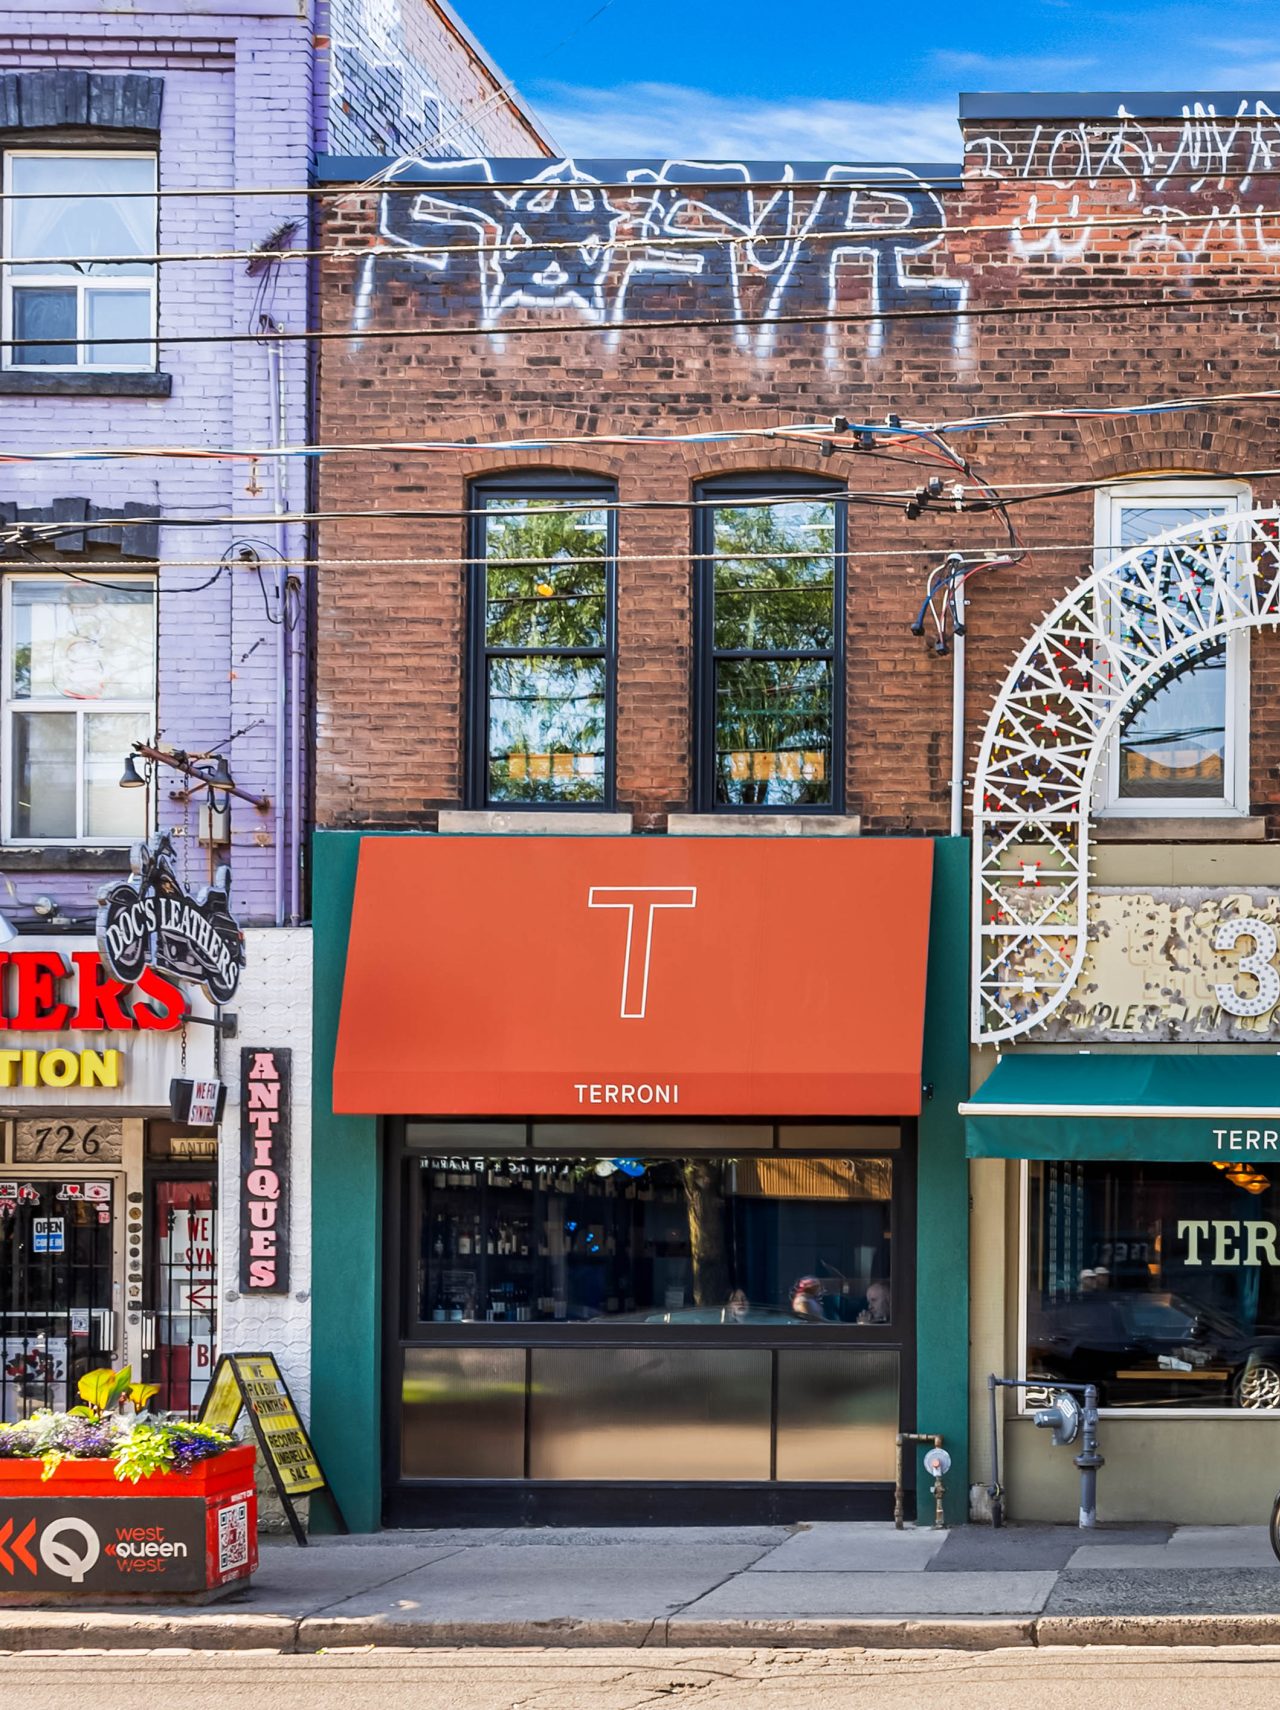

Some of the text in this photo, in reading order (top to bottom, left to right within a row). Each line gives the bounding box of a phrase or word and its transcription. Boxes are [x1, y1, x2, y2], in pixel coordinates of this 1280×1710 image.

[106, 897, 238, 990] DOC'S LEATHERS
[588, 886, 697, 1018] T
[0, 951, 186, 1031] ERS
[196, 1082, 207, 1100] WE
[573, 1083, 680, 1104] TERRONI
[190, 1105, 215, 1123] SYNTHS
[35, 1124, 100, 1156] 726
[246, 1052, 281, 1288] ANTIQUES
[35, 1221, 62, 1234] OPEN
[186, 1217, 209, 1242] WE
[251, 1364, 265, 1378] WE
[256, 1398, 285, 1414] SYNTHS
[267, 1431, 303, 1448] RECORDS
[273, 1447, 312, 1465] UMBRELLA
[289, 1465, 311, 1482] SALE
[115, 1526, 166, 1543] west
[39, 1516, 101, 1583] Q
[116, 1558, 168, 1573] west
